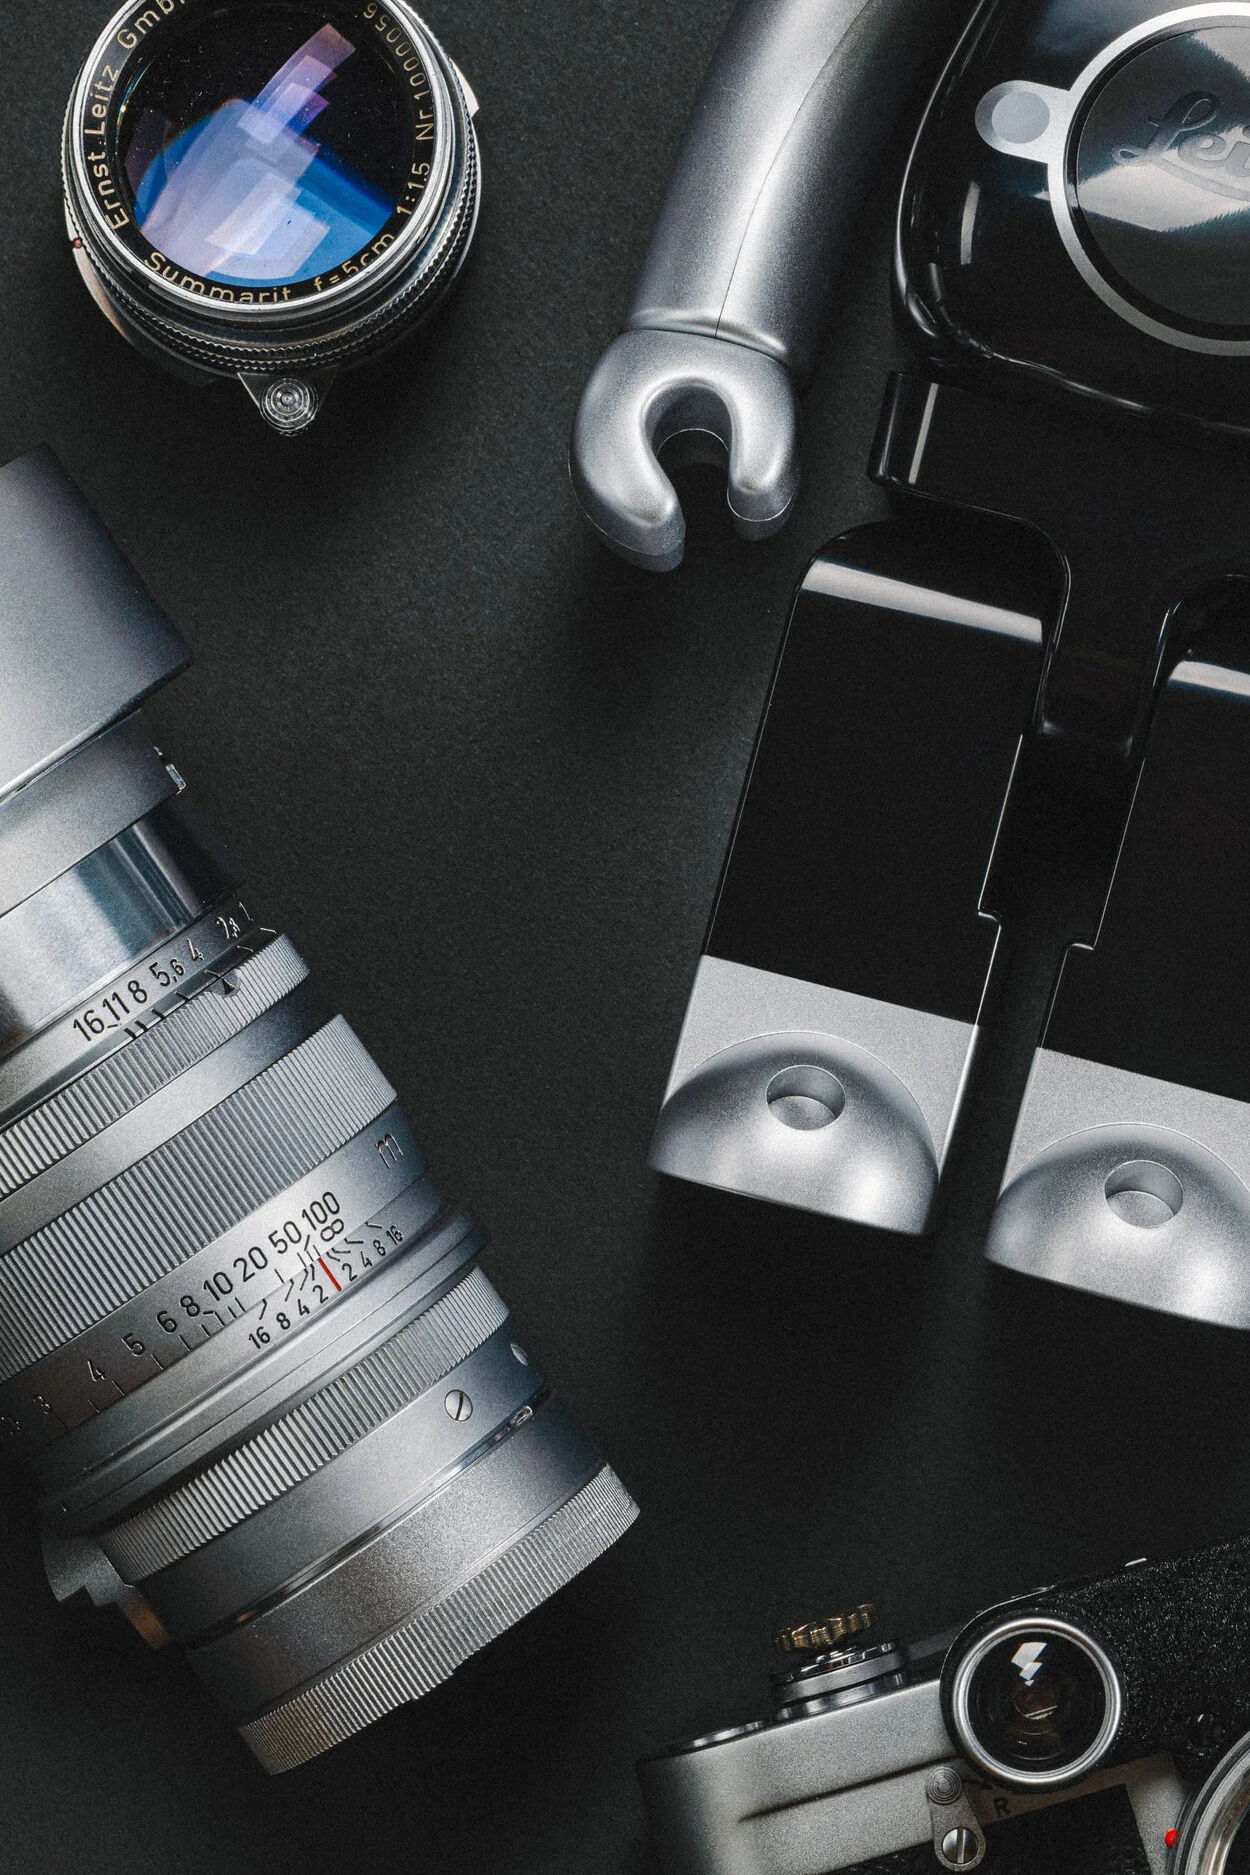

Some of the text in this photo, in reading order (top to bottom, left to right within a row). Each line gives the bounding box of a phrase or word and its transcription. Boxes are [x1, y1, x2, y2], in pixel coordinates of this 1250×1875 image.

[84, 63, 121, 137] Leitz
[86, 151, 130, 232] Ernst
[143, 250, 293, 304] Summarit
[313, 229, 397, 293] f=5cm
[396, 161, 432, 217] 1:1.5
[73, 1008, 105, 1042] 16
[102, 991, 131, 1022] 11
[127, 979, 149, 1005] 8
[187, 938, 205, 962] 4
[86, 1359, 108, 1383] 4
[121, 1332, 147, 1358] 5
[156, 1309, 179, 1336] 6
[179, 1294, 202, 1319] 8
[202, 1270, 235, 1303] 10
[232, 1245, 269, 1284] 20
[267, 1219, 303, 1256] 50
[301, 1190, 342, 1233] 100
[373, 1132, 405, 1171] m
[247, 1223, 405, 1350] 16 8 4 2 2 4 8 16
